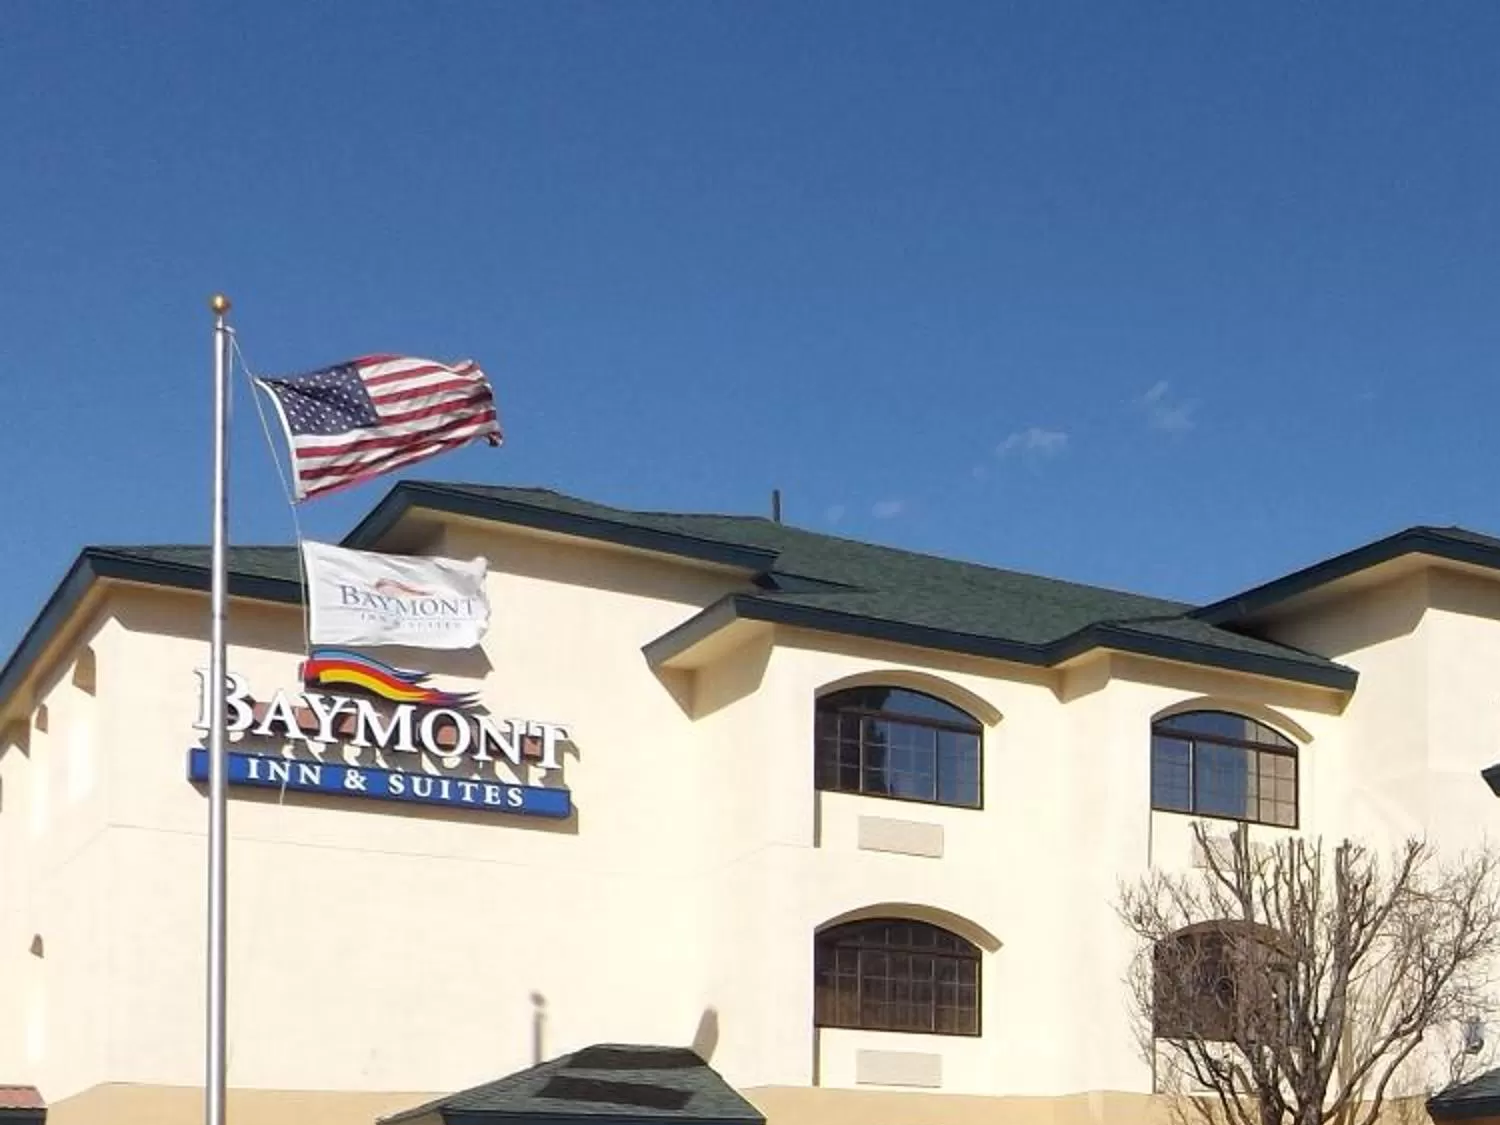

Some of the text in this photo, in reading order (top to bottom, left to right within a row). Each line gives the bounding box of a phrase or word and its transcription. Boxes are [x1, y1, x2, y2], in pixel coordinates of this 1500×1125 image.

[340, 584, 473, 615] BAYMONT
[192, 668, 570, 769] BAYMONT
[247, 758, 524, 807] INN & SUITES
